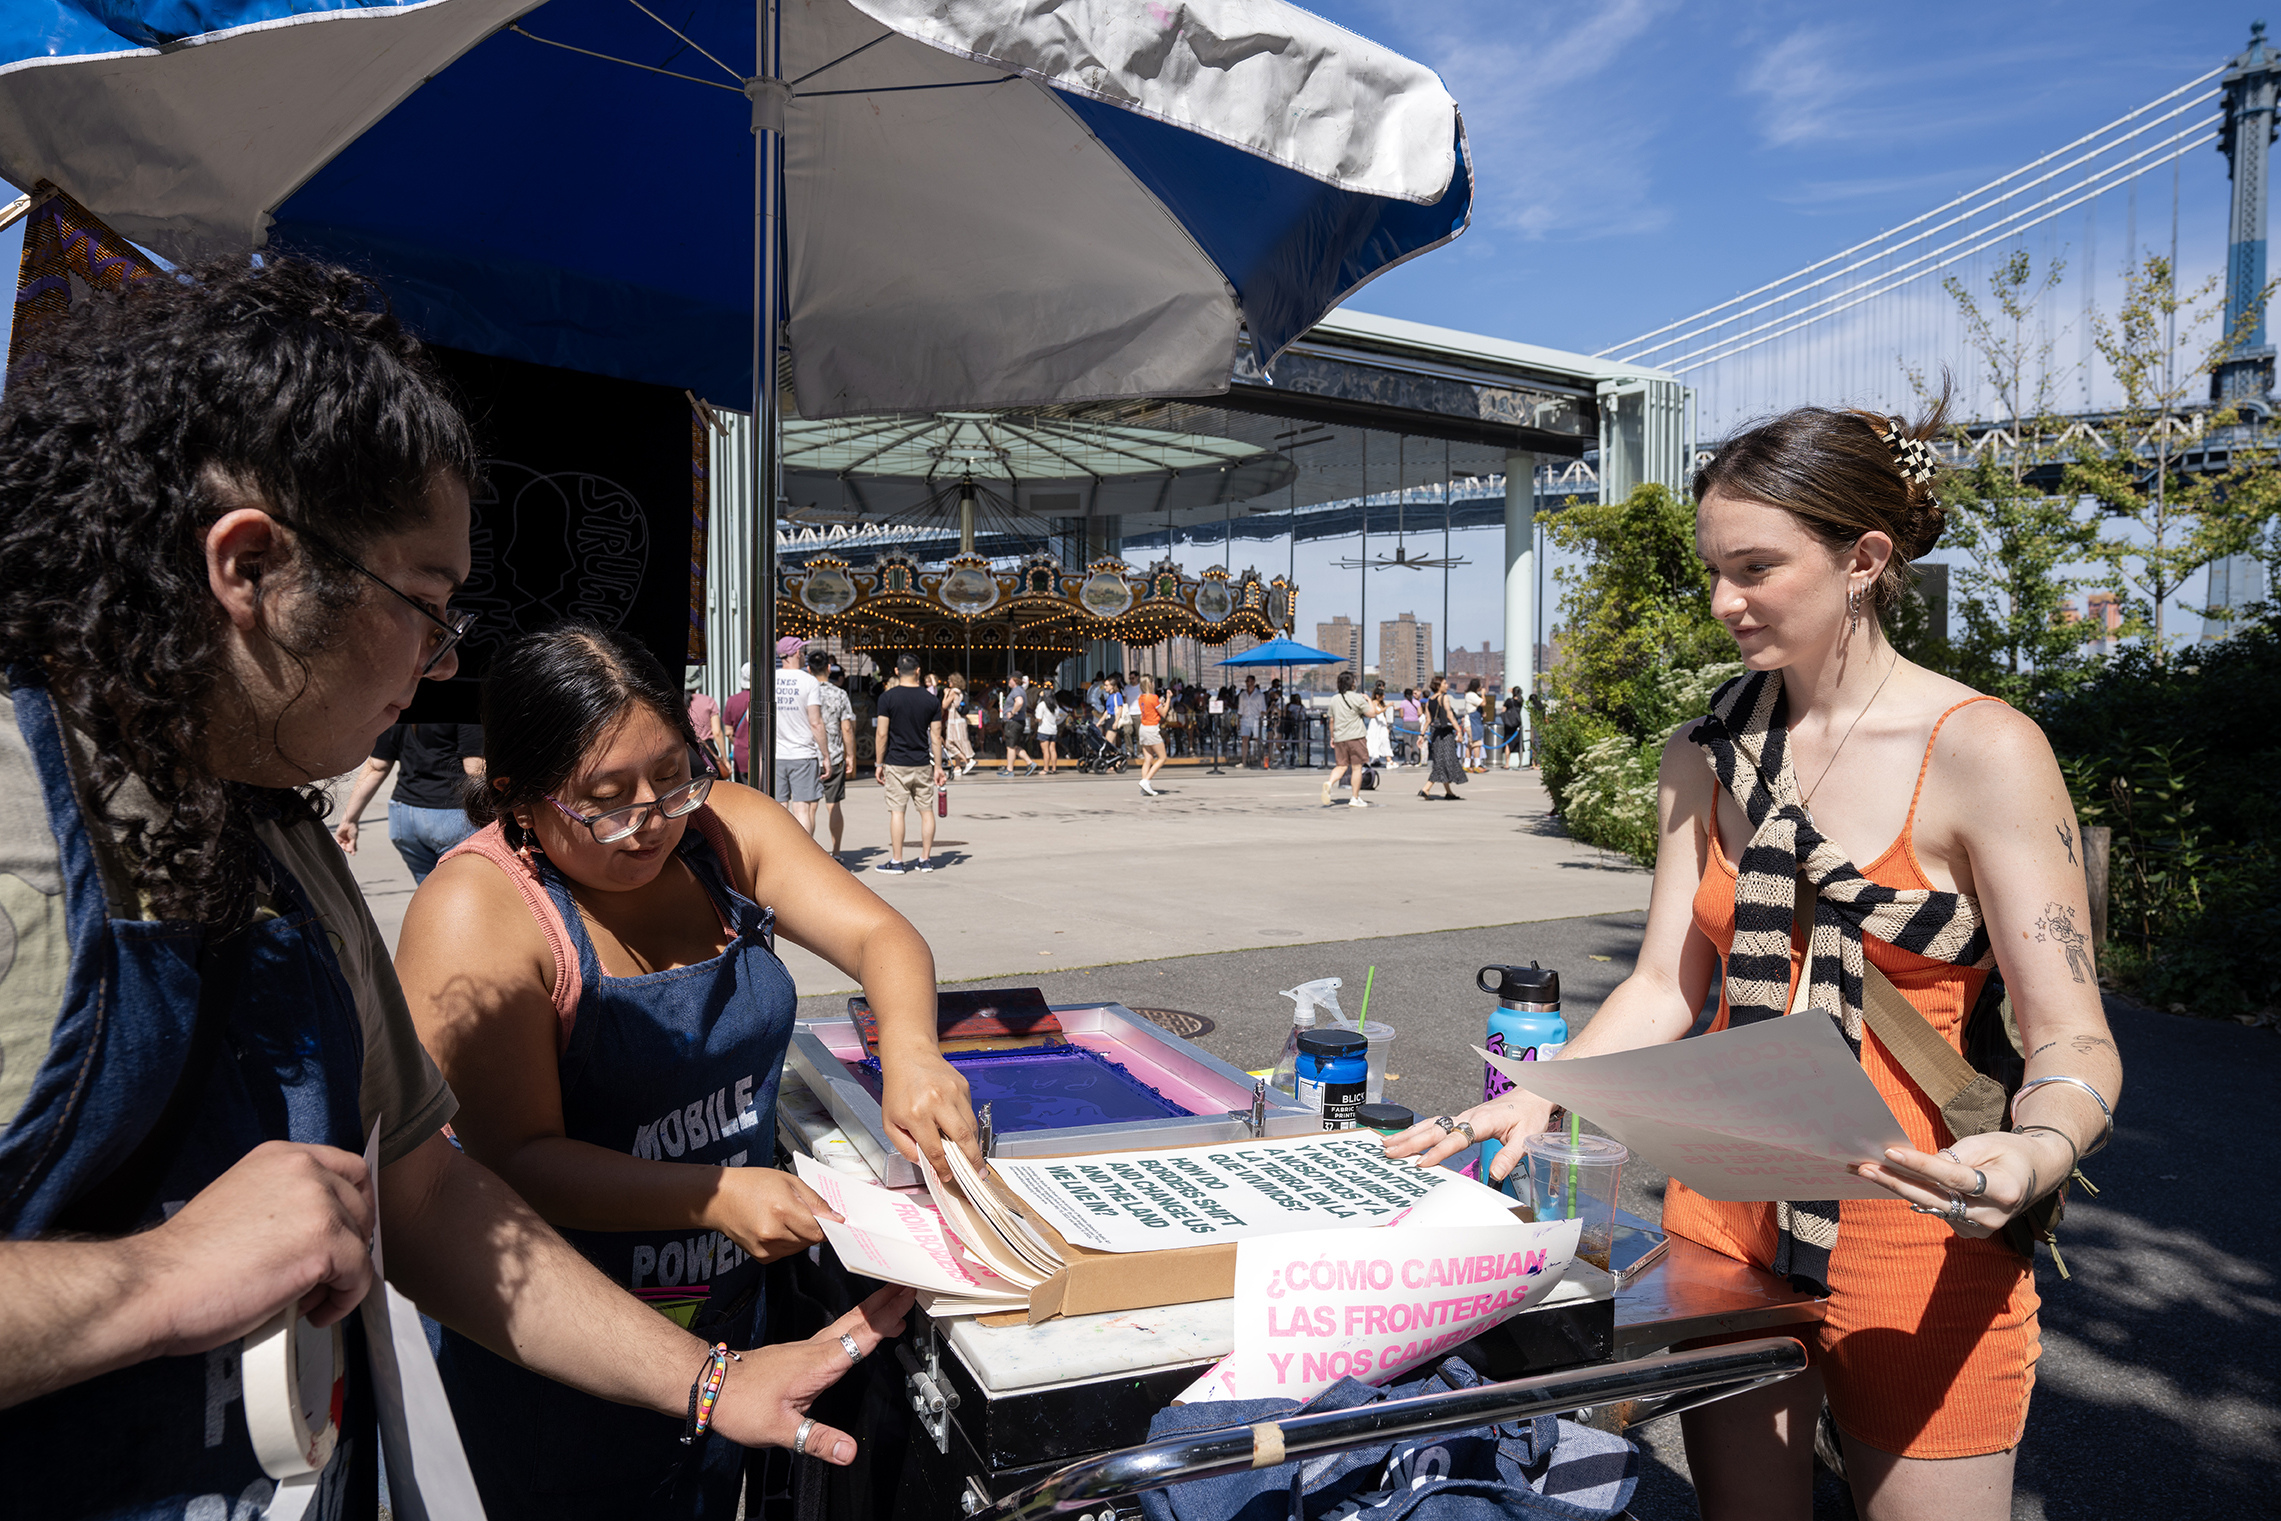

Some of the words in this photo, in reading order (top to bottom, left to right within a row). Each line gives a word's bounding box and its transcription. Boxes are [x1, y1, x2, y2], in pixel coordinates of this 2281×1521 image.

[775, 687, 800, 696] QUOR
[776, 678, 798, 686] INES
[777, 696, 795, 705] HOP
[631, 1074, 759, 1161] MOBILE
[1294, 1143, 1318, 1151] Y
[1303, 1152, 1346, 1170] NOS
[1044, 1165, 1078, 1181] WE
[1167, 1157, 1212, 1176] HOW
[1195, 1176, 1230, 1190] DO
[1207, 1153, 1248, 1172] QUE
[1235, 1169, 1311, 1212] VIVIMOS?
[1235, 1150, 1265, 1163] LA
[1254, 1161, 1313, 1193] TIERRA
[1301, 1191, 1339, 1206] EN
[1323, 1204, 1358, 1219] LA
[1263, 1148, 1287, 1156] A
[1275, 1155, 1364, 1200] NOSOTROS
[1363, 1207, 1391, 1216] A
[1319, 1141, 1359, 1158] LAS
[1347, 1157, 1429, 1198] FRONTER
[1334, 1169, 1412, 1208] CAMBIAN
[1399, 1166, 1448, 1187] CAM
[1059, 1181, 1102, 1202] LIVE
[1074, 1164, 1114, 1184] AND
[1099, 1182, 1139, 1203] THE
[1121, 1201, 1170, 1228] LAND
[1082, 1201, 1120, 1217] IN?
[1105, 1162, 1145, 1181] AND
[1131, 1180, 1198, 1219] CHANGE
[1181, 1218, 1217, 1234] US
[1137, 1159, 1206, 1199] BORDERS
[1191, 1198, 1248, 1227] SHIFT
[891, 1202, 934, 1233] FROM
[1266, 1252, 1394, 1299] ¿CÓMO
[1400, 1248, 1547, 1290] CAMBIAN
[1267, 1305, 1337, 1338] LAS
[1344, 1285, 1529, 1337] FRONTERAS
[1266, 1352, 1296, 1385] Y
[1302, 1348, 1374, 1384] NOS
[1378, 1313, 1509, 1371] CAMBIAN
